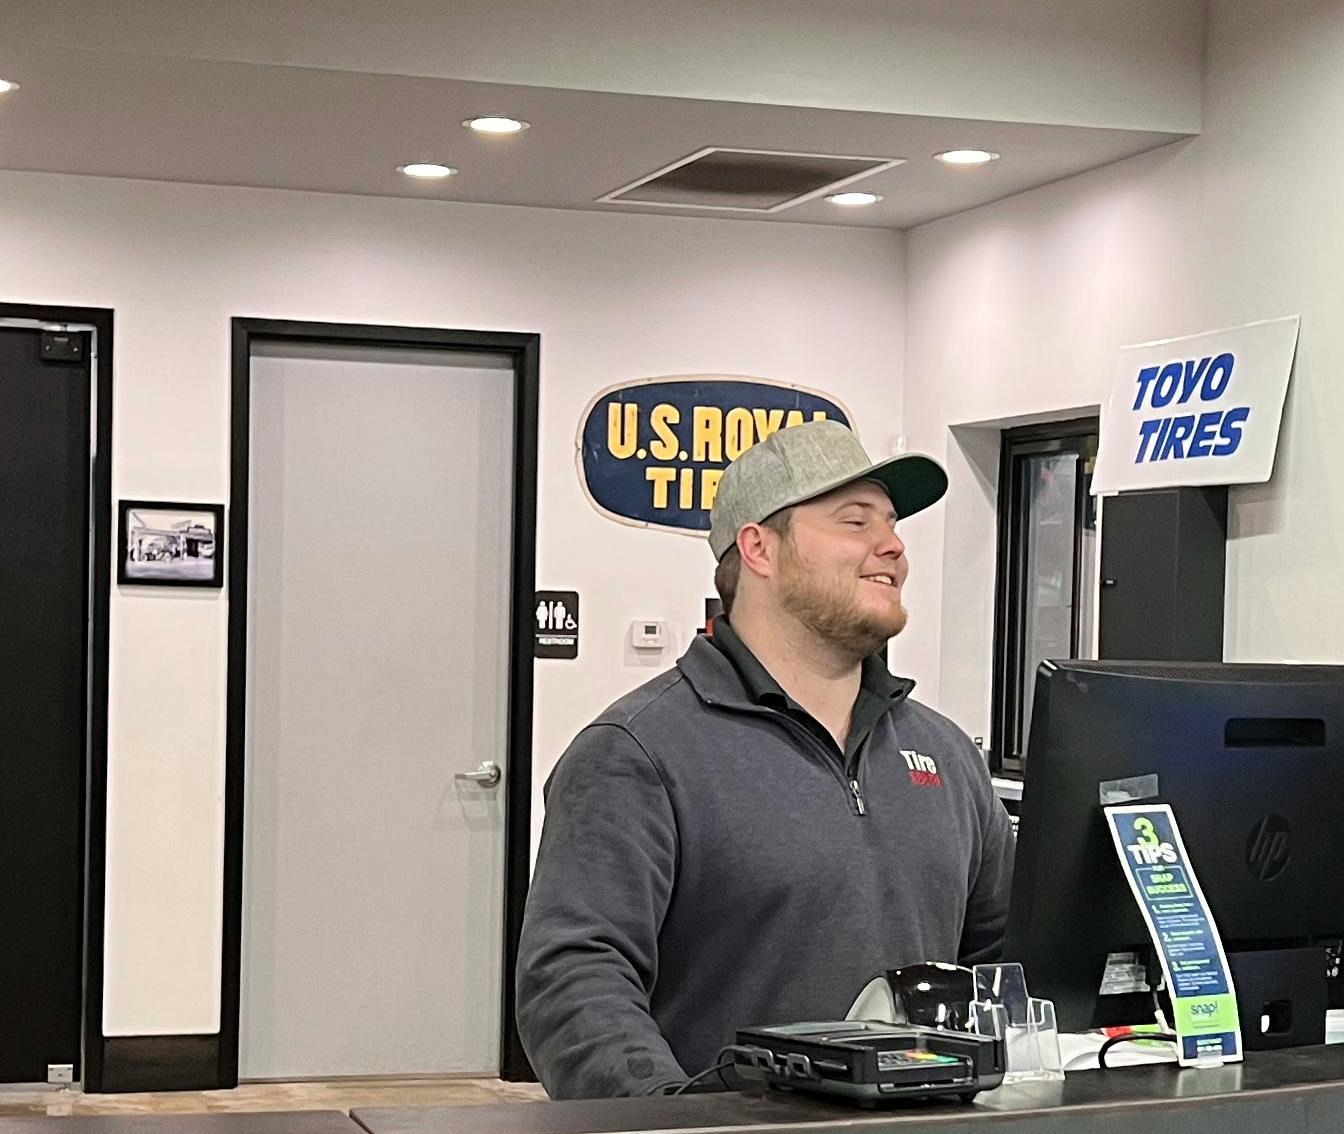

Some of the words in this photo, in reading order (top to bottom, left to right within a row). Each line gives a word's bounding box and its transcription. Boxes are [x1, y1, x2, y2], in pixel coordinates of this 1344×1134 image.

[1132, 353, 1234, 411] TOYO
[608, 402, 687, 461] U.S.
[692, 406, 827, 462] ROY
[1135, 407, 1250, 464] TIRES
[646, 467, 724, 510] TIR
[899, 750, 937, 775] Tire
[1133, 817, 1159, 846] 3
[1126, 842, 1178, 865] TIPS
